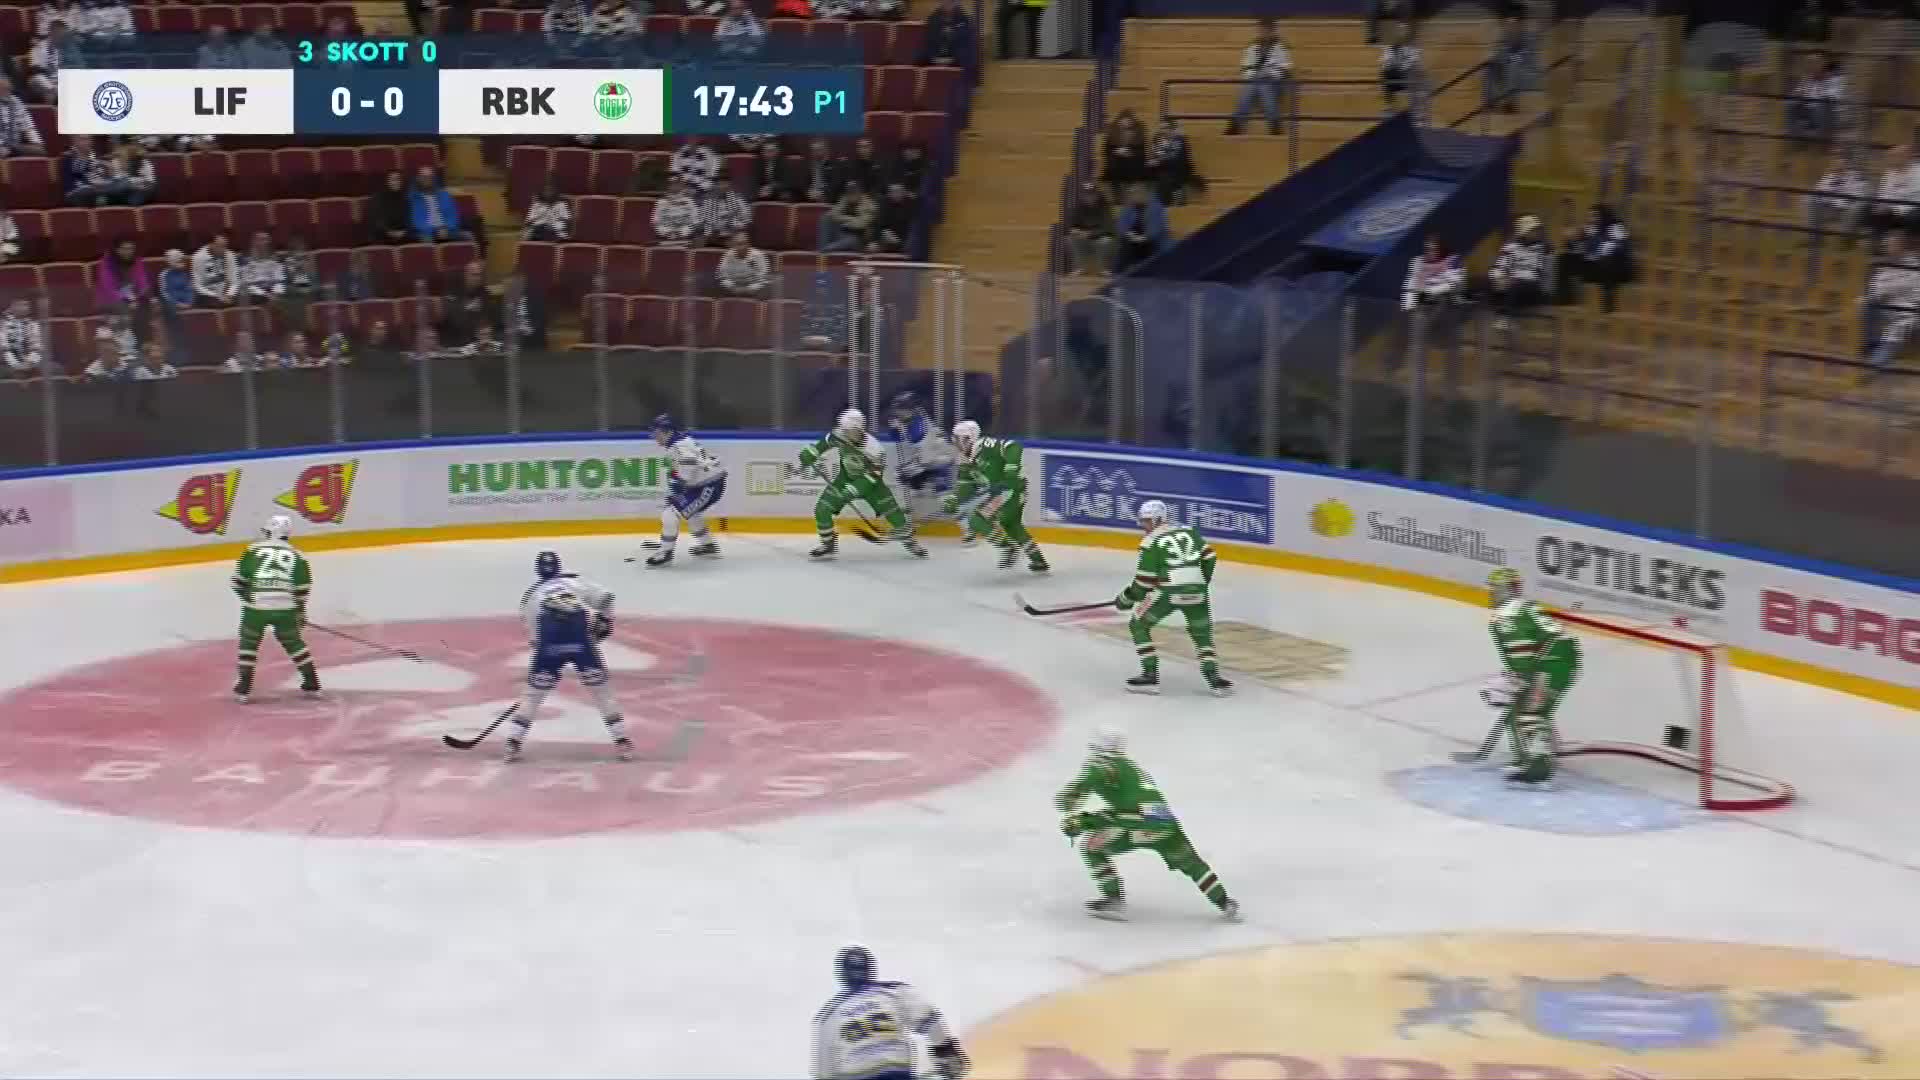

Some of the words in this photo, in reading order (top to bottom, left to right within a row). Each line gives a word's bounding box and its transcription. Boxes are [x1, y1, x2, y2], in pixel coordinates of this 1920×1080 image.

[1049, 485, 1113, 521] TAB
[255, 547, 297, 581] 29
[1157, 531, 1201, 566] 32
[1536, 535, 1726, 611] OPTILEKS
[80, 760, 830, 798] BAUHAUS
